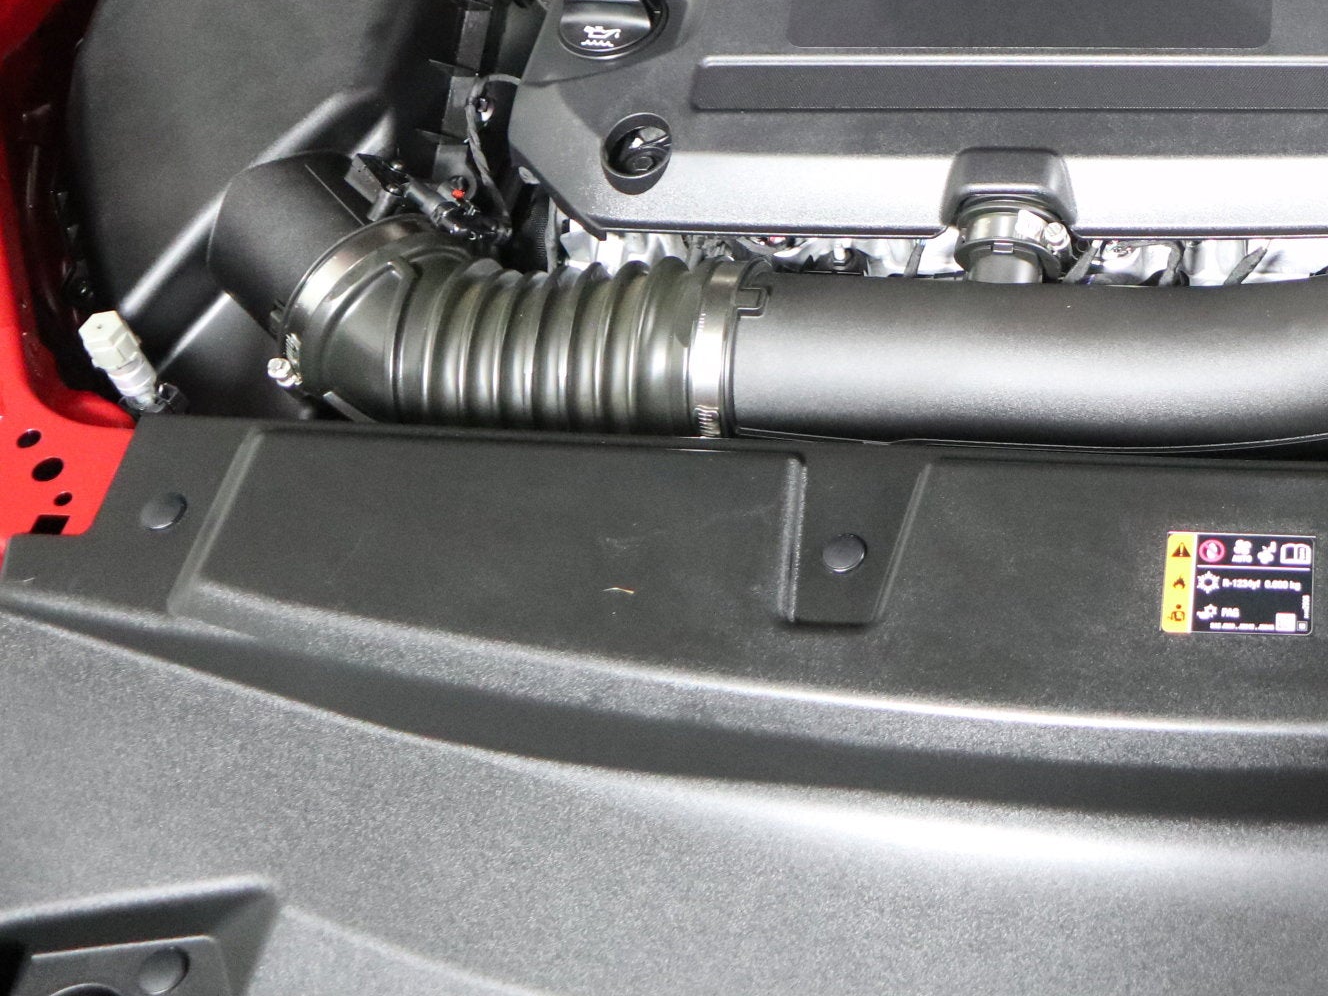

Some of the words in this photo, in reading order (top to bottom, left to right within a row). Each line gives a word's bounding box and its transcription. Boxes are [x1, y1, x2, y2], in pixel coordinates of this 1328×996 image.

[1231, 554, 1252, 563] AUTO
[1290, 580, 1301, 591] kg
[1221, 607, 1240, 618] PAG
